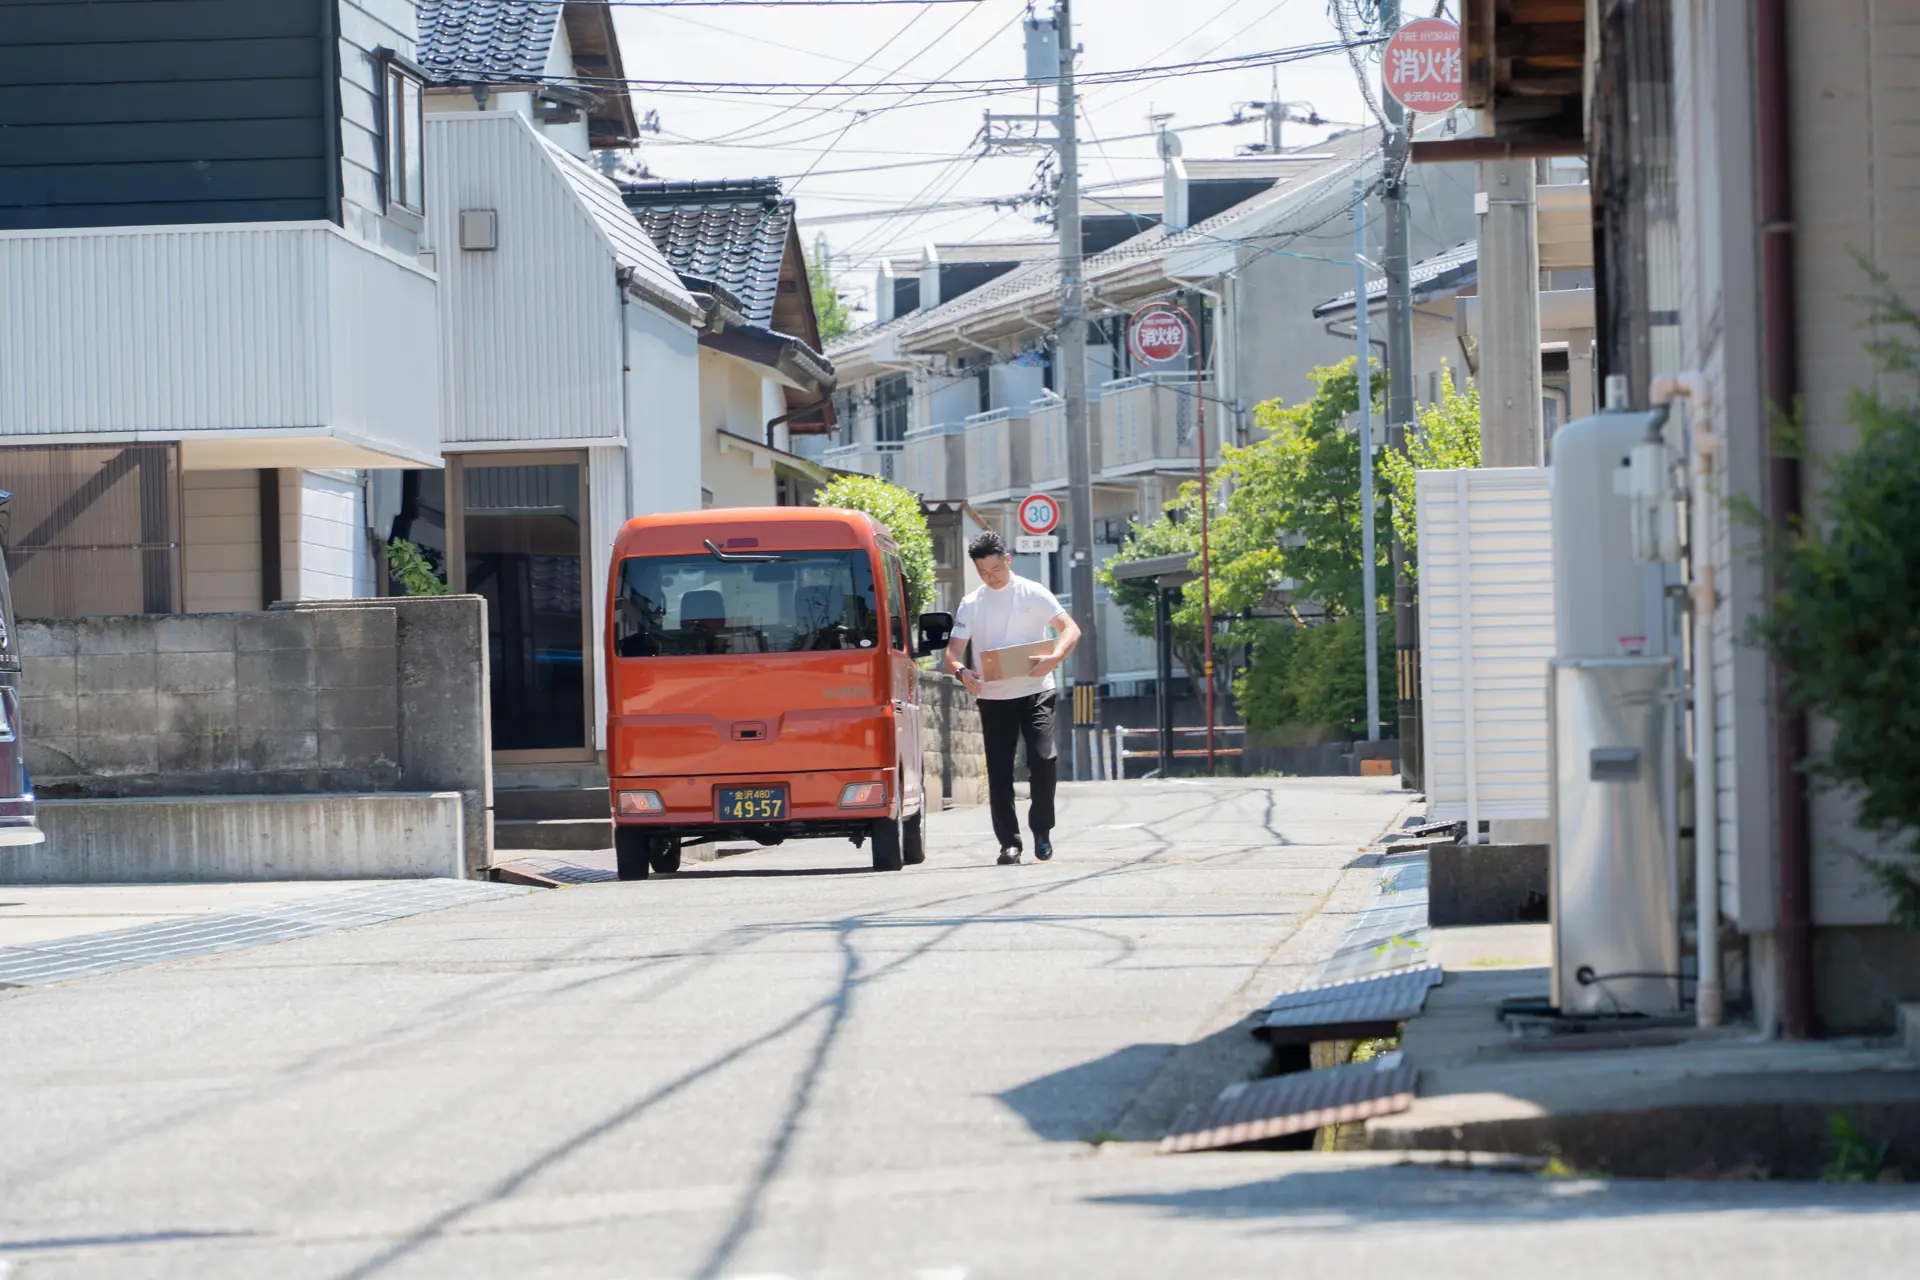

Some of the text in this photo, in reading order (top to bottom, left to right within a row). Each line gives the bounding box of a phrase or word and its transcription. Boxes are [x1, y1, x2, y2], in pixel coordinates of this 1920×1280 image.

[1399, 30, 1460, 42] FIRE HYDRANT
[1392, 47, 1462, 84] 消火栓
[1141, 326, 1181, 347] 消火栓
[1028, 505, 1051, 523] 30
[733, 799, 782, 818] 49-57
